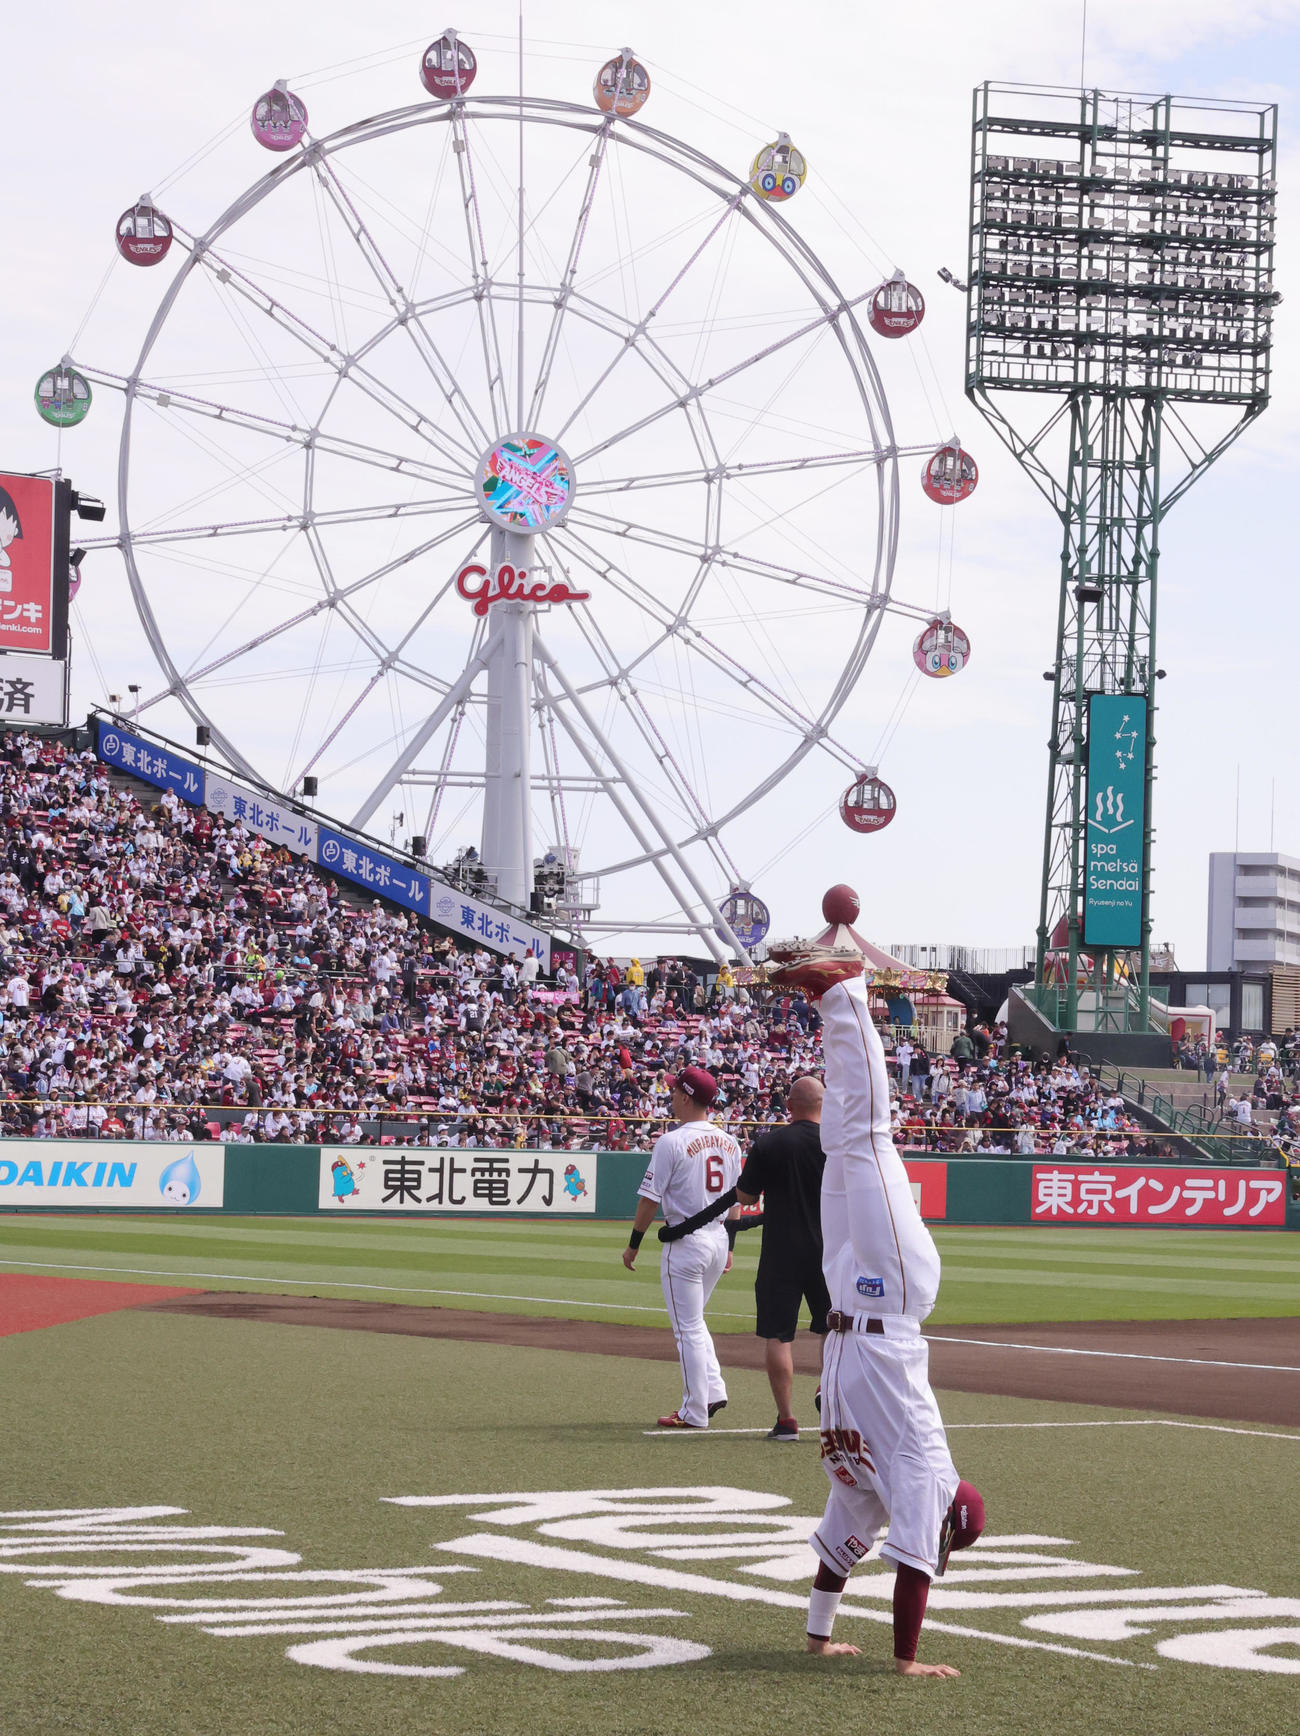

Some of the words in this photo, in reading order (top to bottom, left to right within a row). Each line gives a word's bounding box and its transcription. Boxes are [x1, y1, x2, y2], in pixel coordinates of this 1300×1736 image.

[457, 564, 590, 616] Glico
[0, 598, 42, 623] ンキ
[0, 622, 42, 634] enki.com
[121, 741, 199, 793] 東北ポール
[232, 795, 312, 847] 東北ポール
[1090, 843, 1117, 857] spa
[1090, 858, 1138, 873] metsä
[342, 847, 424, 902] 東北ポール
[1089, 876, 1139, 891] Sendai
[460, 904, 545, 959] 東北ポール
[687, 1136, 736, 1158] MURABAYASHI
[0, 1161, 137, 1187] DAIKIN
[381, 1156, 554, 1207] 東北電力
[706, 1155, 723, 1192] 6
[1035, 1170, 1282, 1217] 東京インテリア
